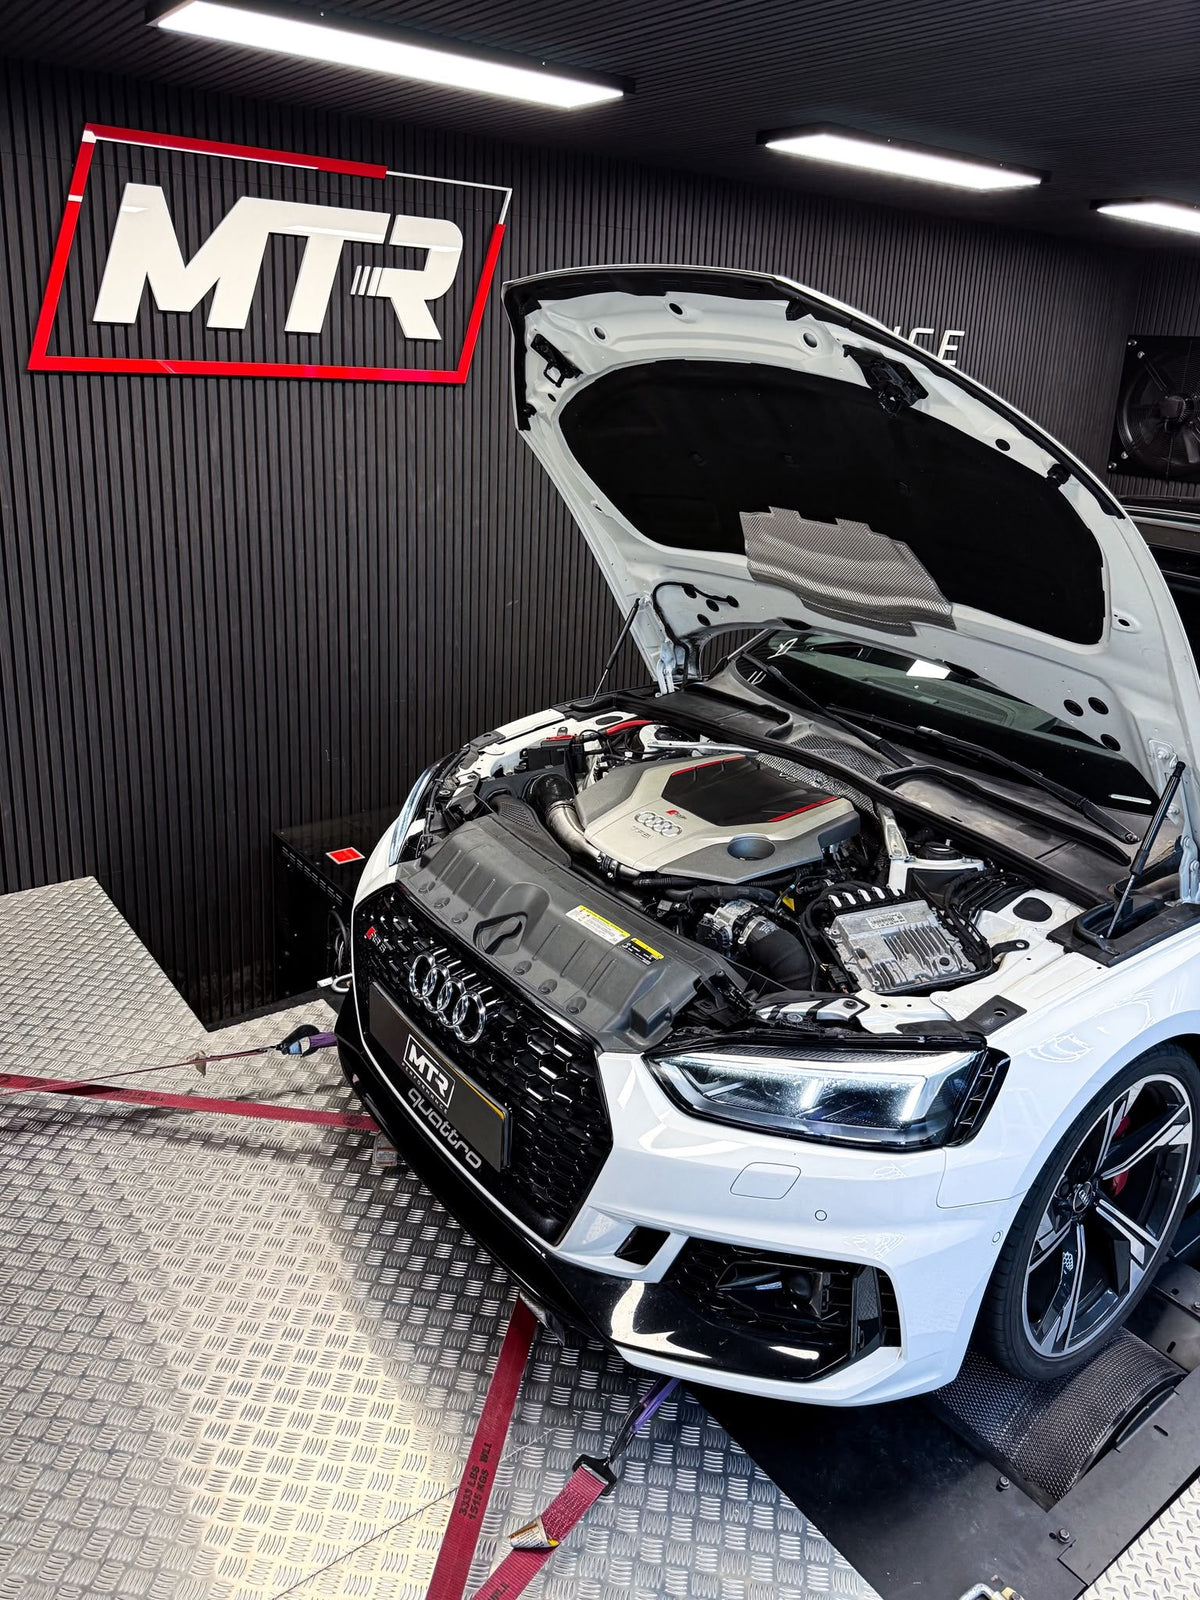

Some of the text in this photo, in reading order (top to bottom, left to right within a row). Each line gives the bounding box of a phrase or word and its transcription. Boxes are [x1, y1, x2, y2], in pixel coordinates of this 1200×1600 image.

[92, 182, 464, 341] MTR
[401, 1061, 448, 1115] PERFORMANCE
[408, 1043, 449, 1098] MTR
[408, 1087, 482, 1169] quattro
